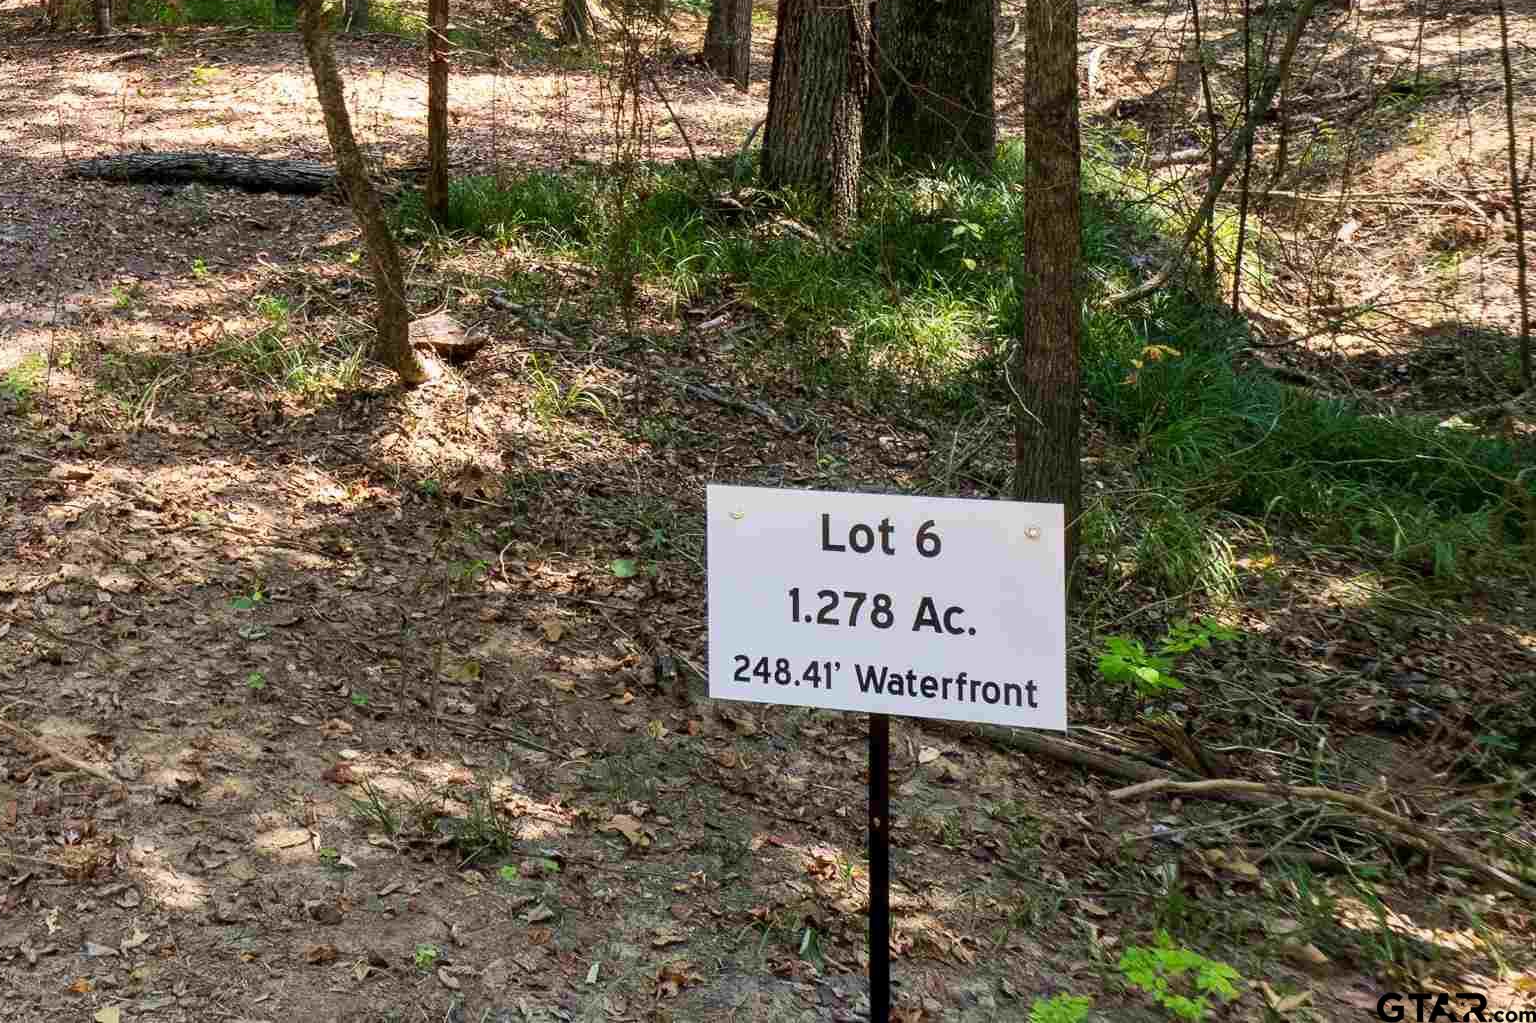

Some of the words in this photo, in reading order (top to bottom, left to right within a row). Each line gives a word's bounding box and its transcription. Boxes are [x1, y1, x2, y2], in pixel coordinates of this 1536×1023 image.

[821, 513, 896, 556] Lot
[915, 519, 942, 558] 6
[788, 587, 895, 630] 1.278
[911, 596, 977, 636] Ac.
[854, 663, 1039, 709] Waterfront
